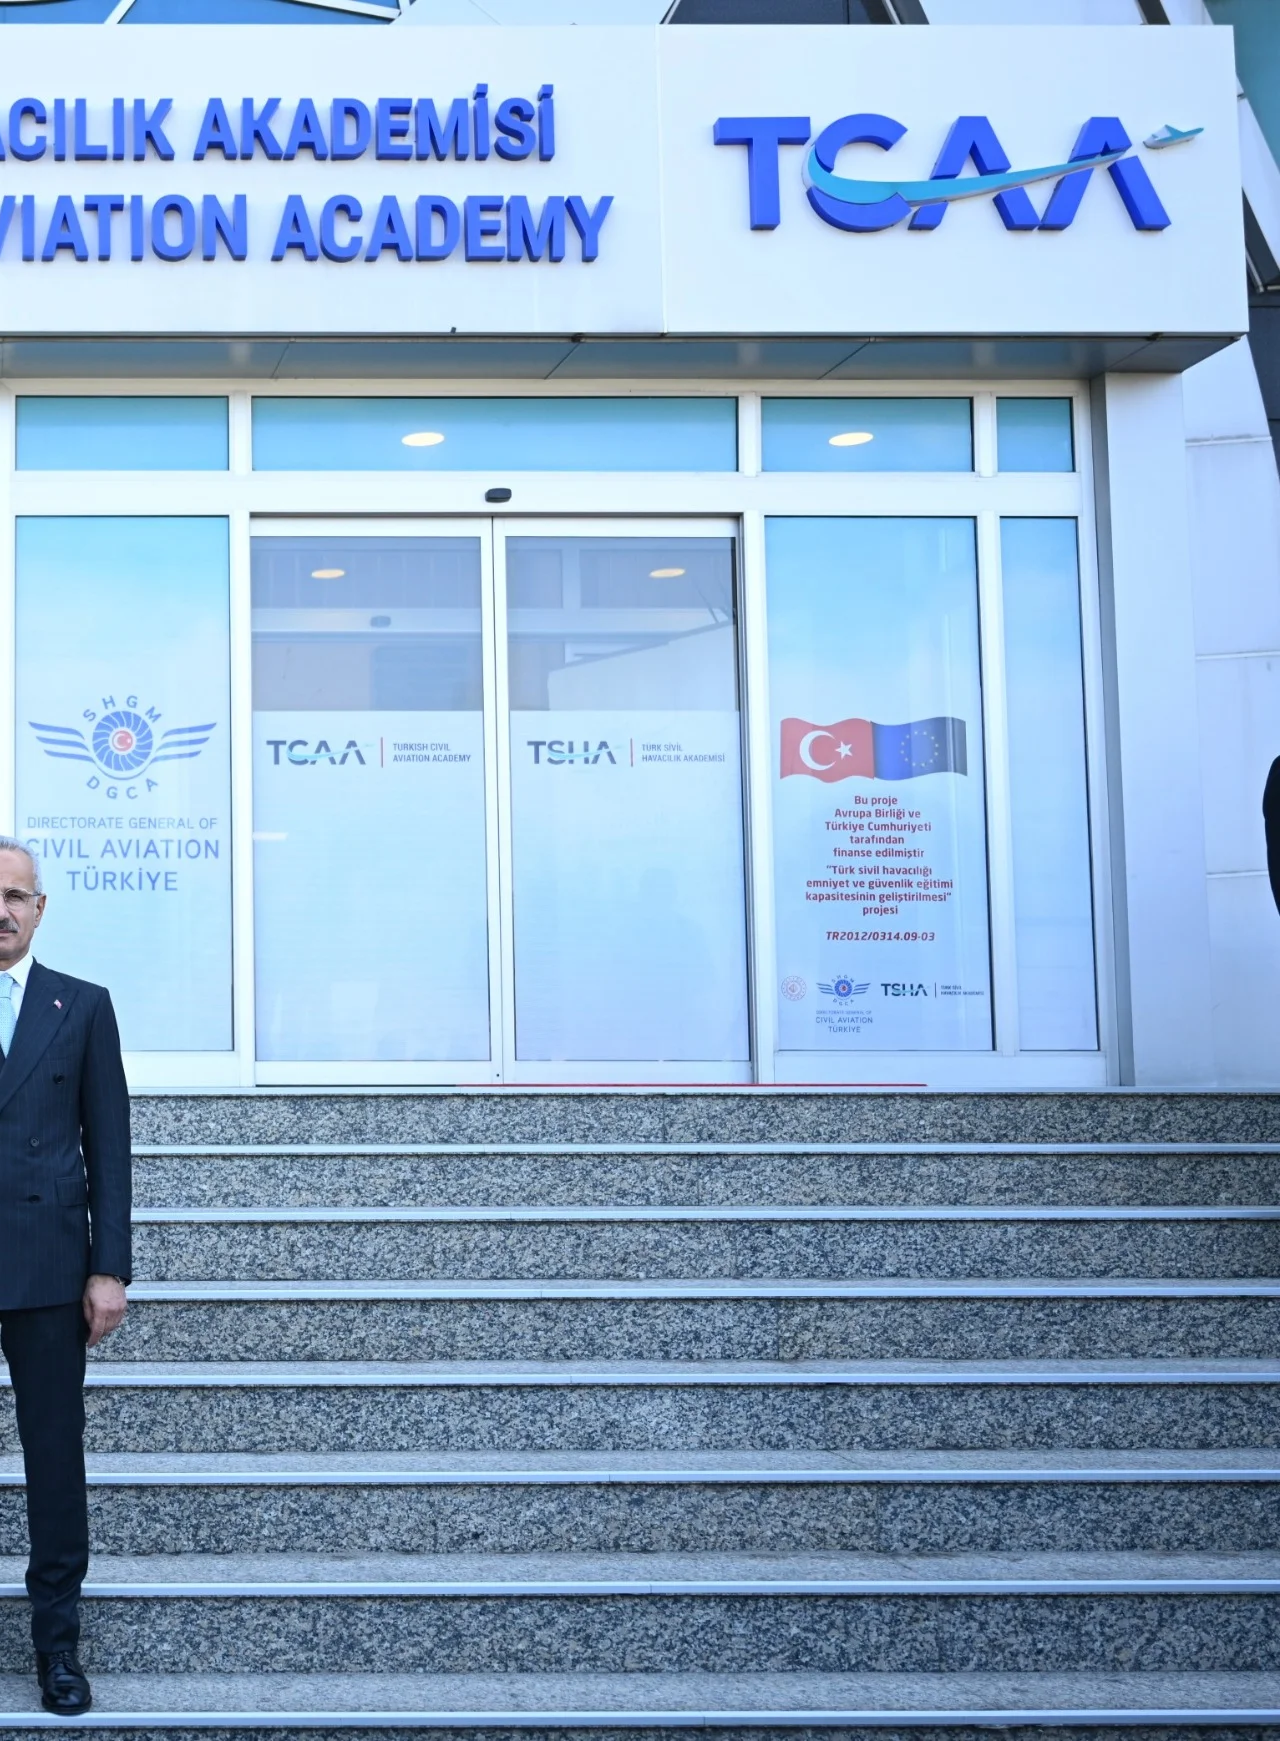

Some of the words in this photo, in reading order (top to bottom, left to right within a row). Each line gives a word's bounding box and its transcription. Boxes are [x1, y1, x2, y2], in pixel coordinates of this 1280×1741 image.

[193, 83, 555, 162] AKADEMİSİ
[713, 113, 1172, 232] TCAA
[271, 194, 614, 263] ACADEMY
[82, 695, 162, 723] SHGM
[266, 739, 367, 766] TCAA
[392, 742, 428, 752] TURKISH
[430, 742, 452, 752] CIVIL
[527, 740, 617, 766] TSHA
[641, 742, 662, 752] TÜRK
[663, 742, 684, 752] SİVİL
[392, 754, 430, 763] AVIATION
[432, 754, 472, 763] ACADEMY
[641, 754, 682, 763] HAVACILIK
[682, 752, 726, 763] AKADEMİSİ
[86, 775, 159, 800] DGCA
[854, 795, 869, 805] Bu
[871, 795, 898, 807] proje
[834, 809, 872, 820] Avrupa
[874, 808, 906, 820] Birliği
[908, 810, 922, 818] ve
[27, 816, 123, 830] DIRECTORATE
[128, 816, 195, 830] GENERAL
[198, 816, 218, 830] OF
[824, 822, 865, 833] Türkiye
[868, 822, 932, 833] Cumhuriyeti
[850, 835, 905, 845] tarafından
[100, 838, 220, 860] AVIATION
[832, 848, 873, 858] finanse
[875, 848, 925, 860] edilmiştir
[858, 865, 880, 875] sivil
[882, 865, 933, 877] havacılığı
[67, 866, 178, 891] TÜRKİYE
[806, 878, 850, 890] emniyet
[852, 880, 866, 888] ve
[868, 878, 914, 890] güvenlik
[916, 878, 954, 890] eğitimi
[806, 892, 876, 904] kapasitesinin
[862, 906, 898, 917] projesi
[826, 931, 936, 942] TR2012/0314.09-03
[880, 983, 928, 996] TSHA
[816, 1016, 834, 1024] CIVIL
[838, 1016, 873, 1024] AVIATION
[828, 1025, 861, 1033] TÜRKİYE
